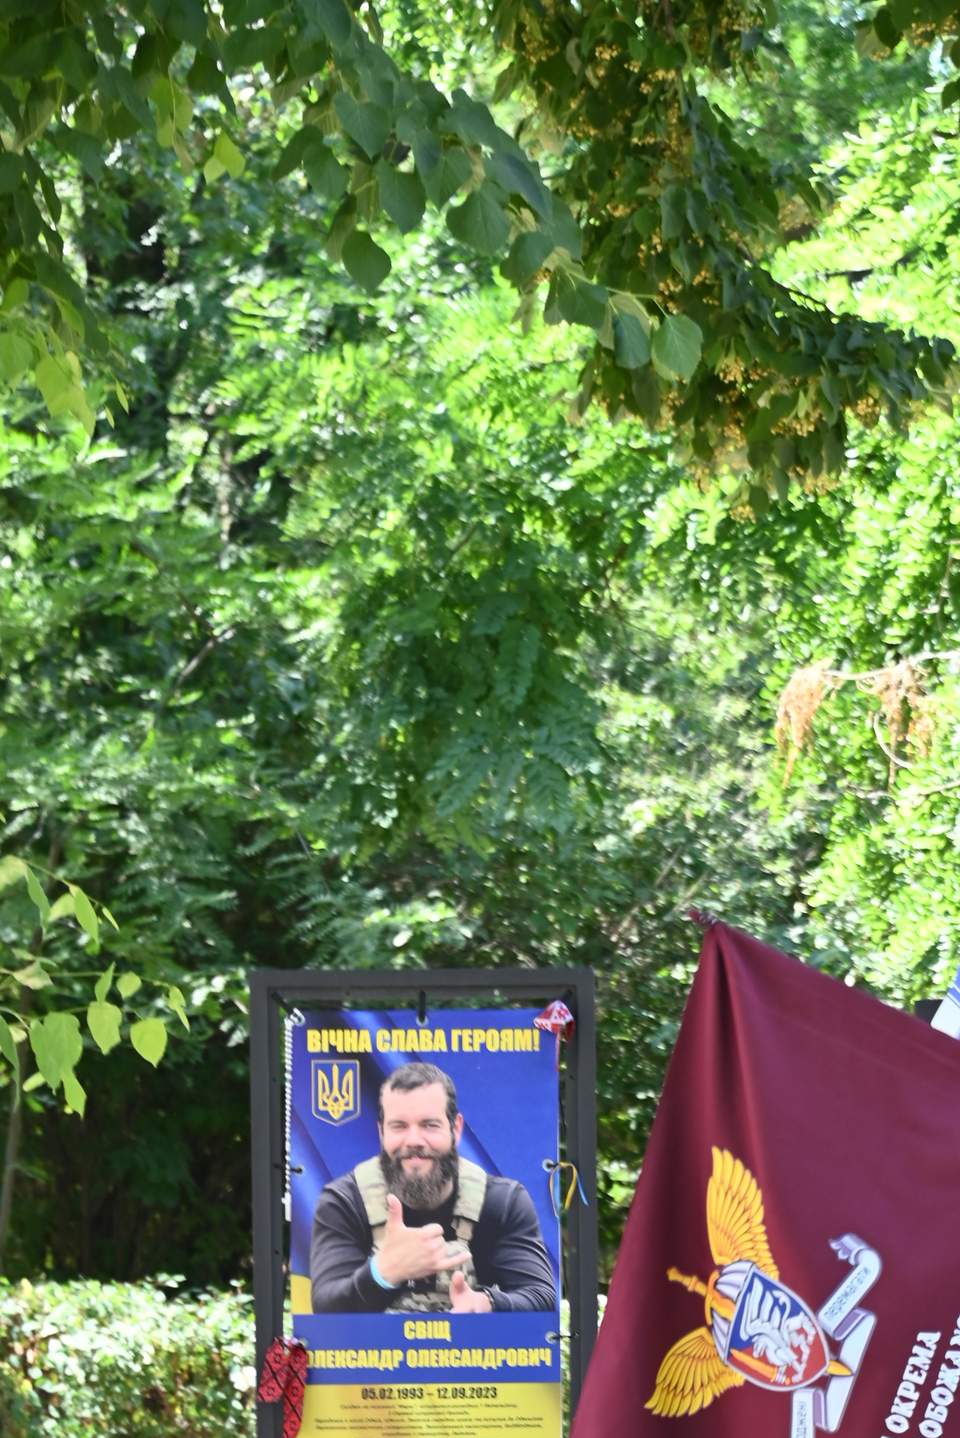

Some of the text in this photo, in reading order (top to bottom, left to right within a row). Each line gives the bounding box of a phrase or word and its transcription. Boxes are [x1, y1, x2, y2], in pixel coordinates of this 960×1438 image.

[306, 1028, 541, 1053] ВІЧНА СЛАВА ГЕРОЯМ!
[403, 1320, 452, 1342] СВІЩ
[406, 1347, 553, 1371] ОЛЕКСАНДРОВИЧ
[361, 1387, 424, 1400] 05.02.1993
[437, 1385, 498, 1400] 12.09.2023
[885, 1331, 941, 1434] ОКРЕМА
